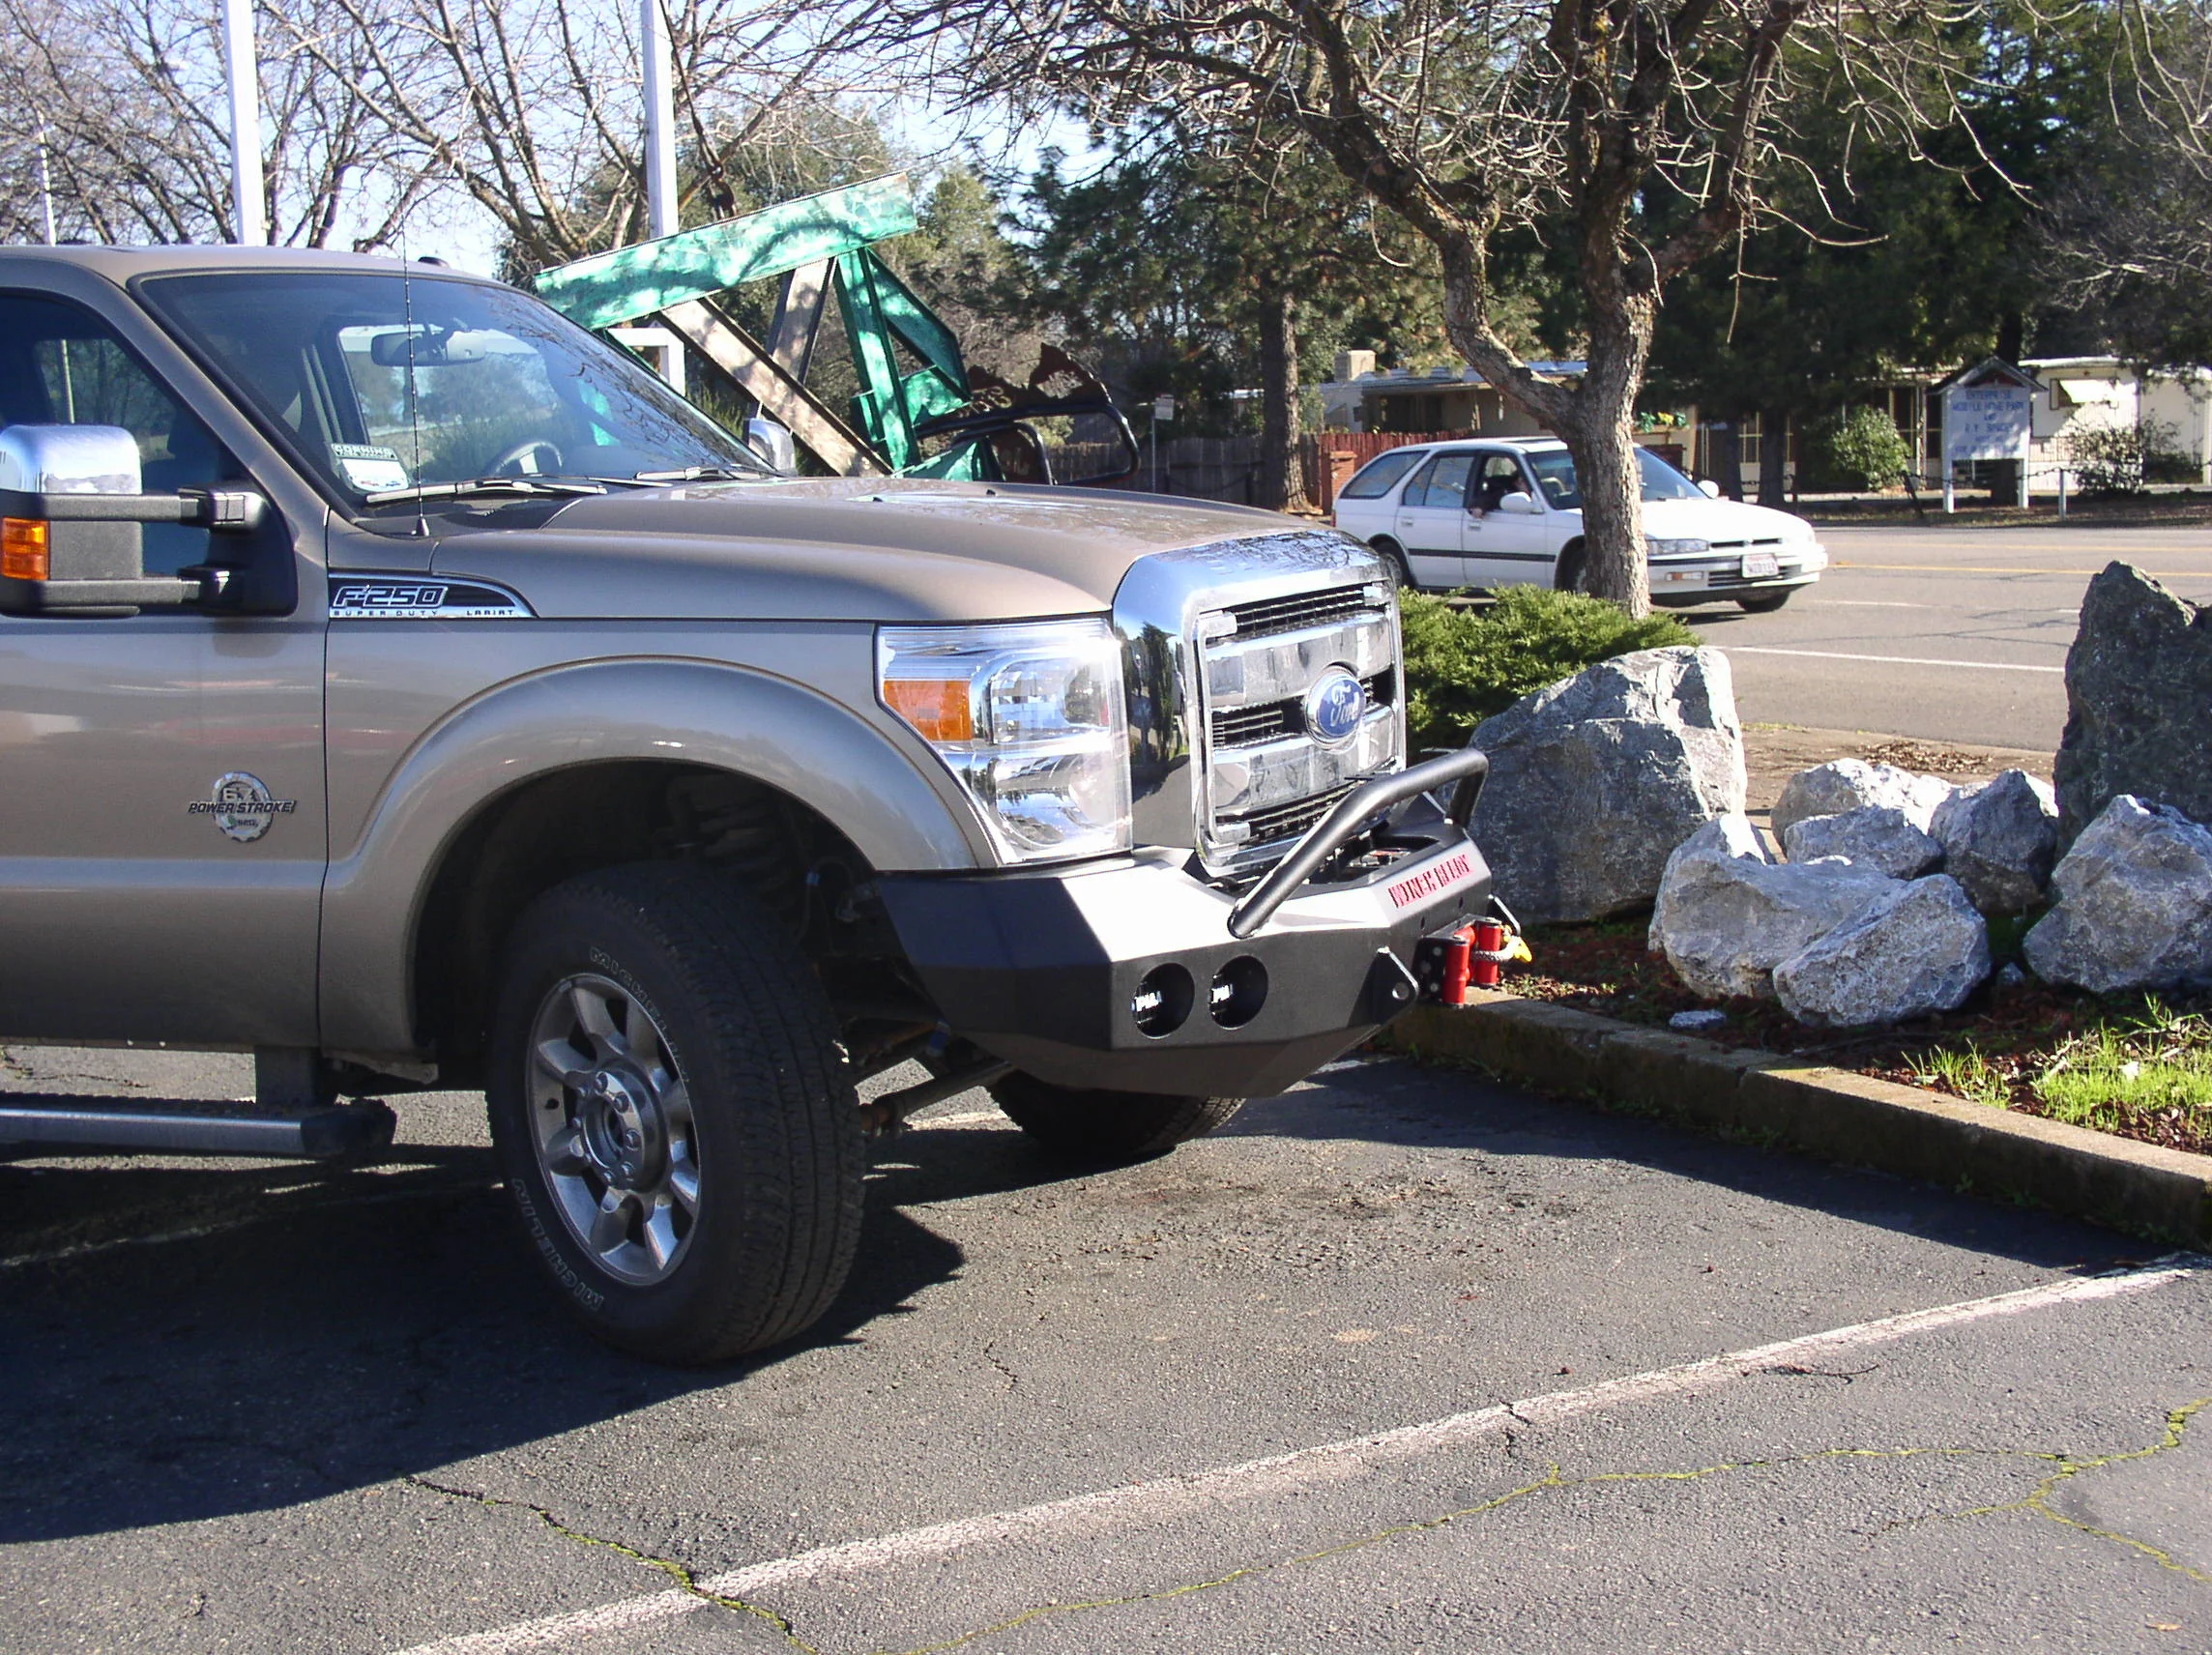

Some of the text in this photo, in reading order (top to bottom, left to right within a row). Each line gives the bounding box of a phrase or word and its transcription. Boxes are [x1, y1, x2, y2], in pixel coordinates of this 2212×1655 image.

[333, 584, 449, 608] F-250
[1330, 684, 1360, 727] Ford
[188, 800, 294, 814] POWER STROKE
[589, 946, 690, 1084] MICHELIN
[511, 1177, 604, 1312] MICHELIN
